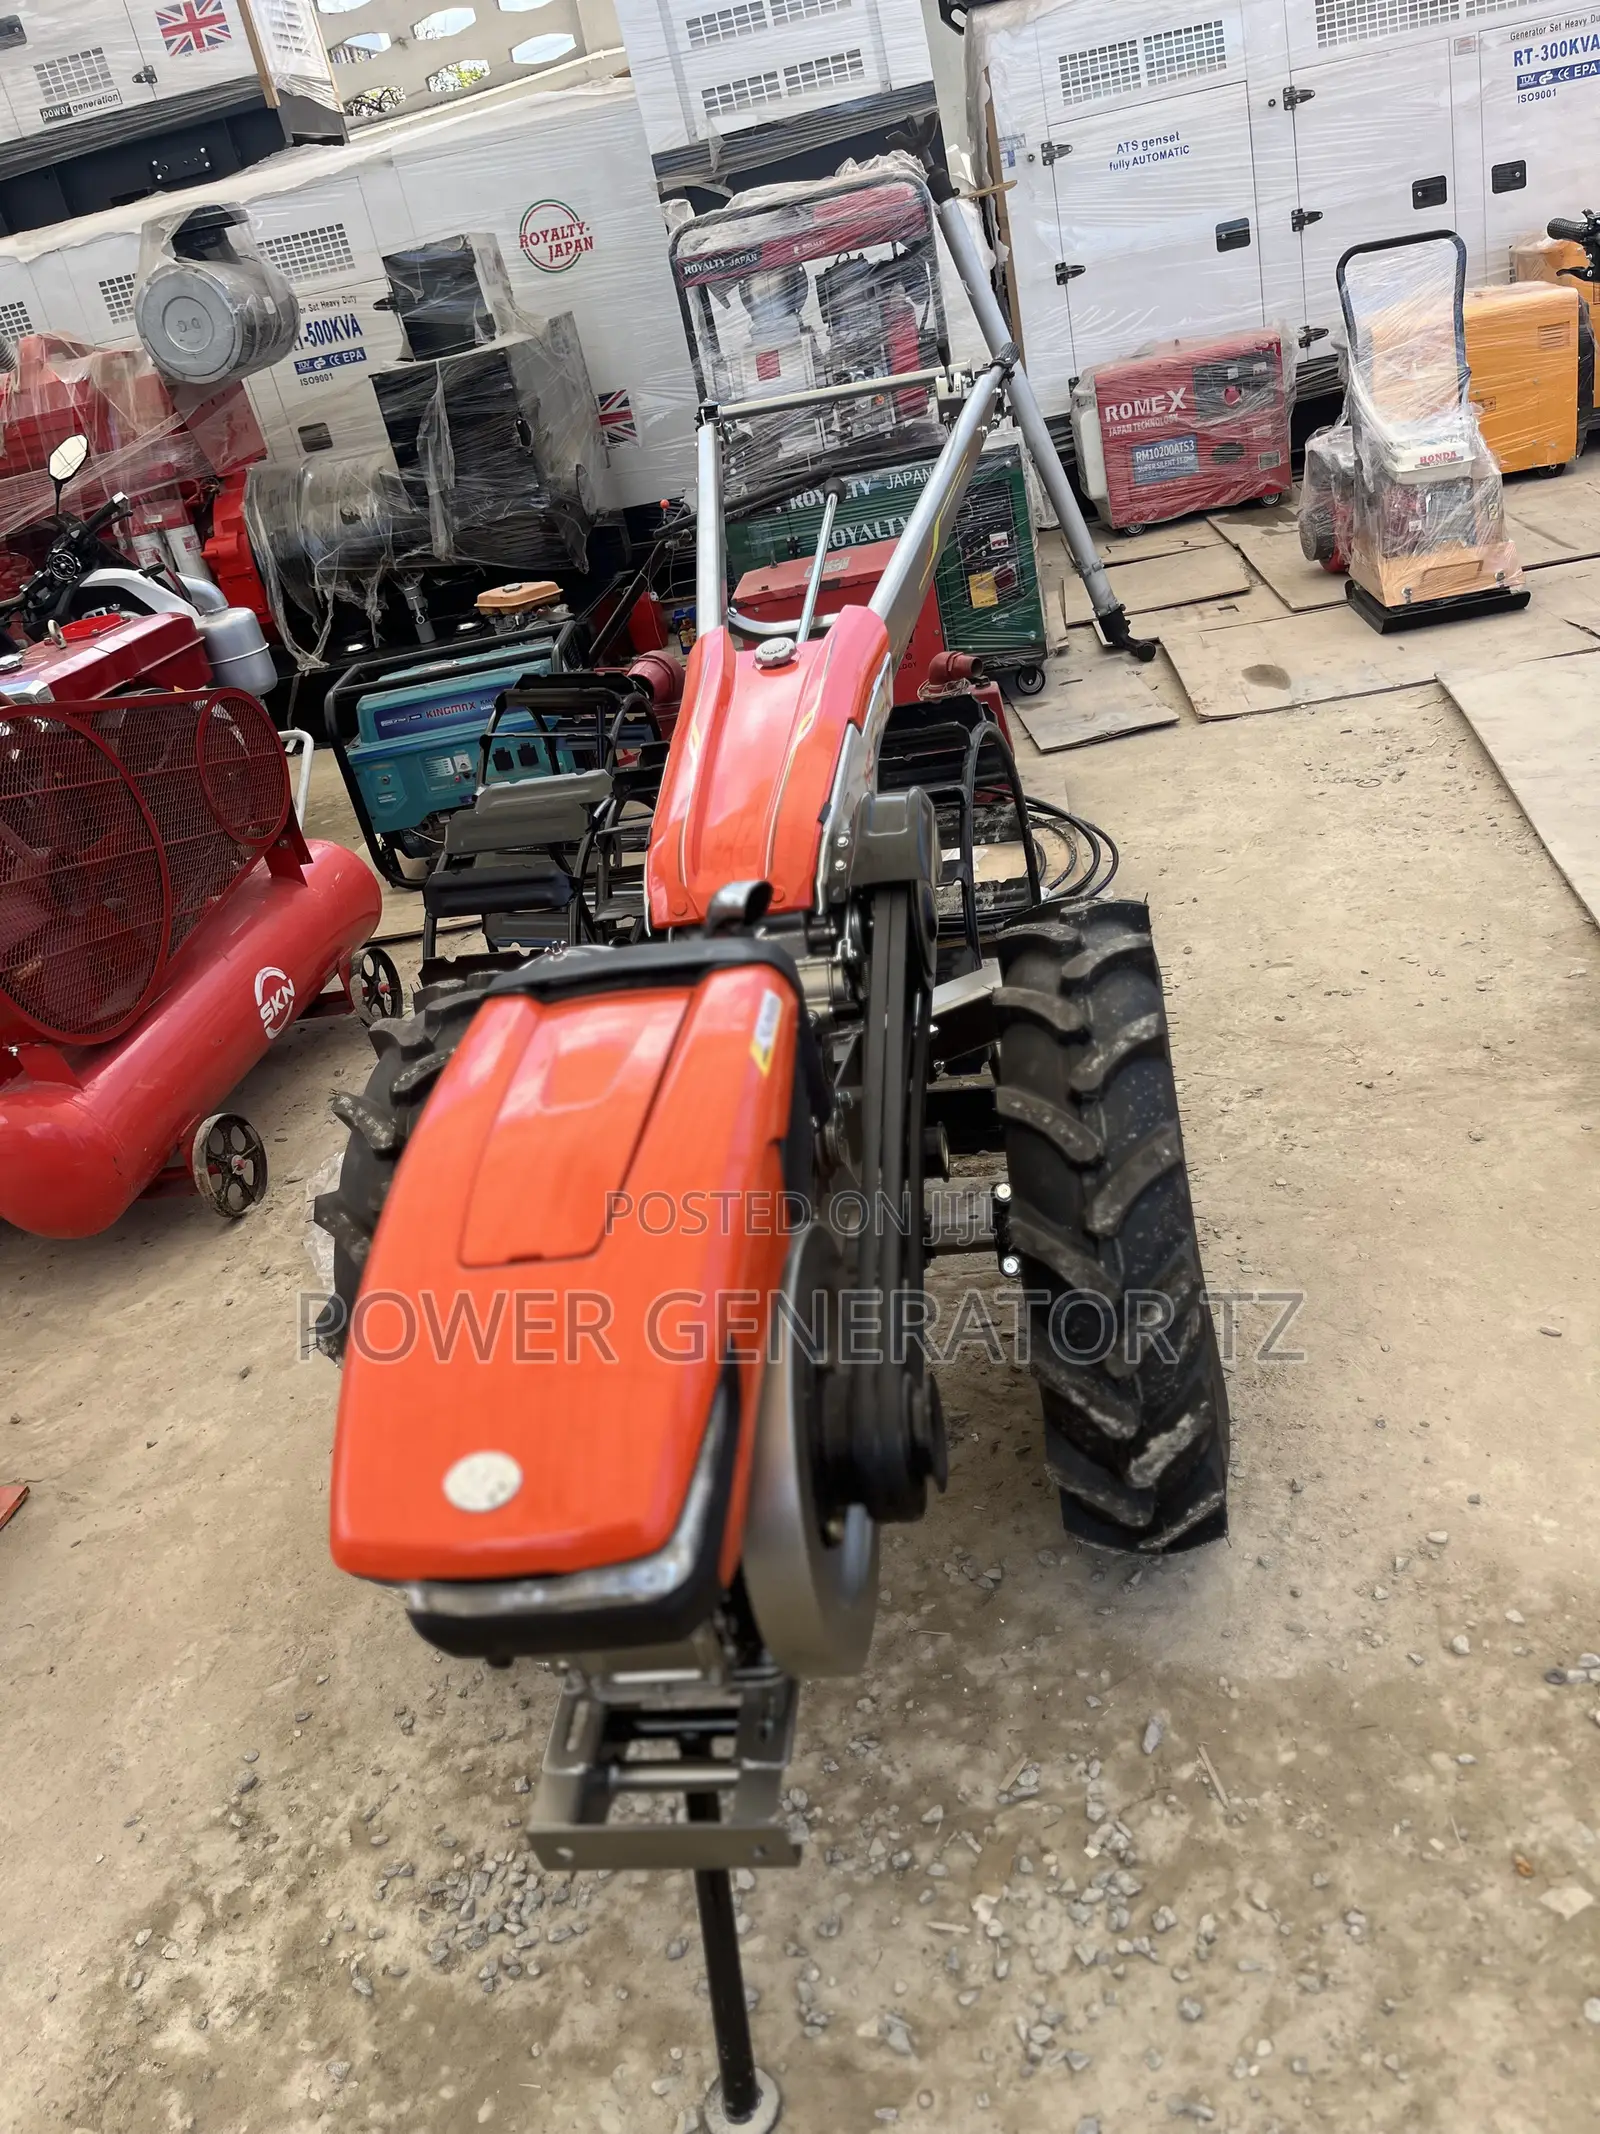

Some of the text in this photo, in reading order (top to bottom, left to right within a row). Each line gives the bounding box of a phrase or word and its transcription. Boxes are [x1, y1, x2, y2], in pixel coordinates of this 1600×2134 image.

[1510, 26, 1547, 41] Generator
[1549, 22, 1562, 33] Set
[1564, 17, 1587, 30] Heavy
[1513, 34, 1600, 67] RT-300KVA
[1574, 62, 1598, 77] EPA
[42, 93, 119, 121] power generation
[1517, 88, 1557, 104] ISO9001
[1116, 130, 1181, 155] ATS genset
[1109, 144, 1190, 171] fully AUTOMATIC
[548, 236, 594, 263] JAPAN
[684, 257, 726, 276] ROYALTY
[320, 299, 340, 309] Heavy
[342, 350, 364, 362] EPA
[300, 372, 334, 386] ISO9001
[1104, 387, 1187, 423] ROMEX
[1108, 423, 1132, 438] JAPAN
[1135, 439, 1195, 463] RM10200ATS3
[1419, 450, 1457, 464] HONDA
[260, 978, 296, 1028] SKN
